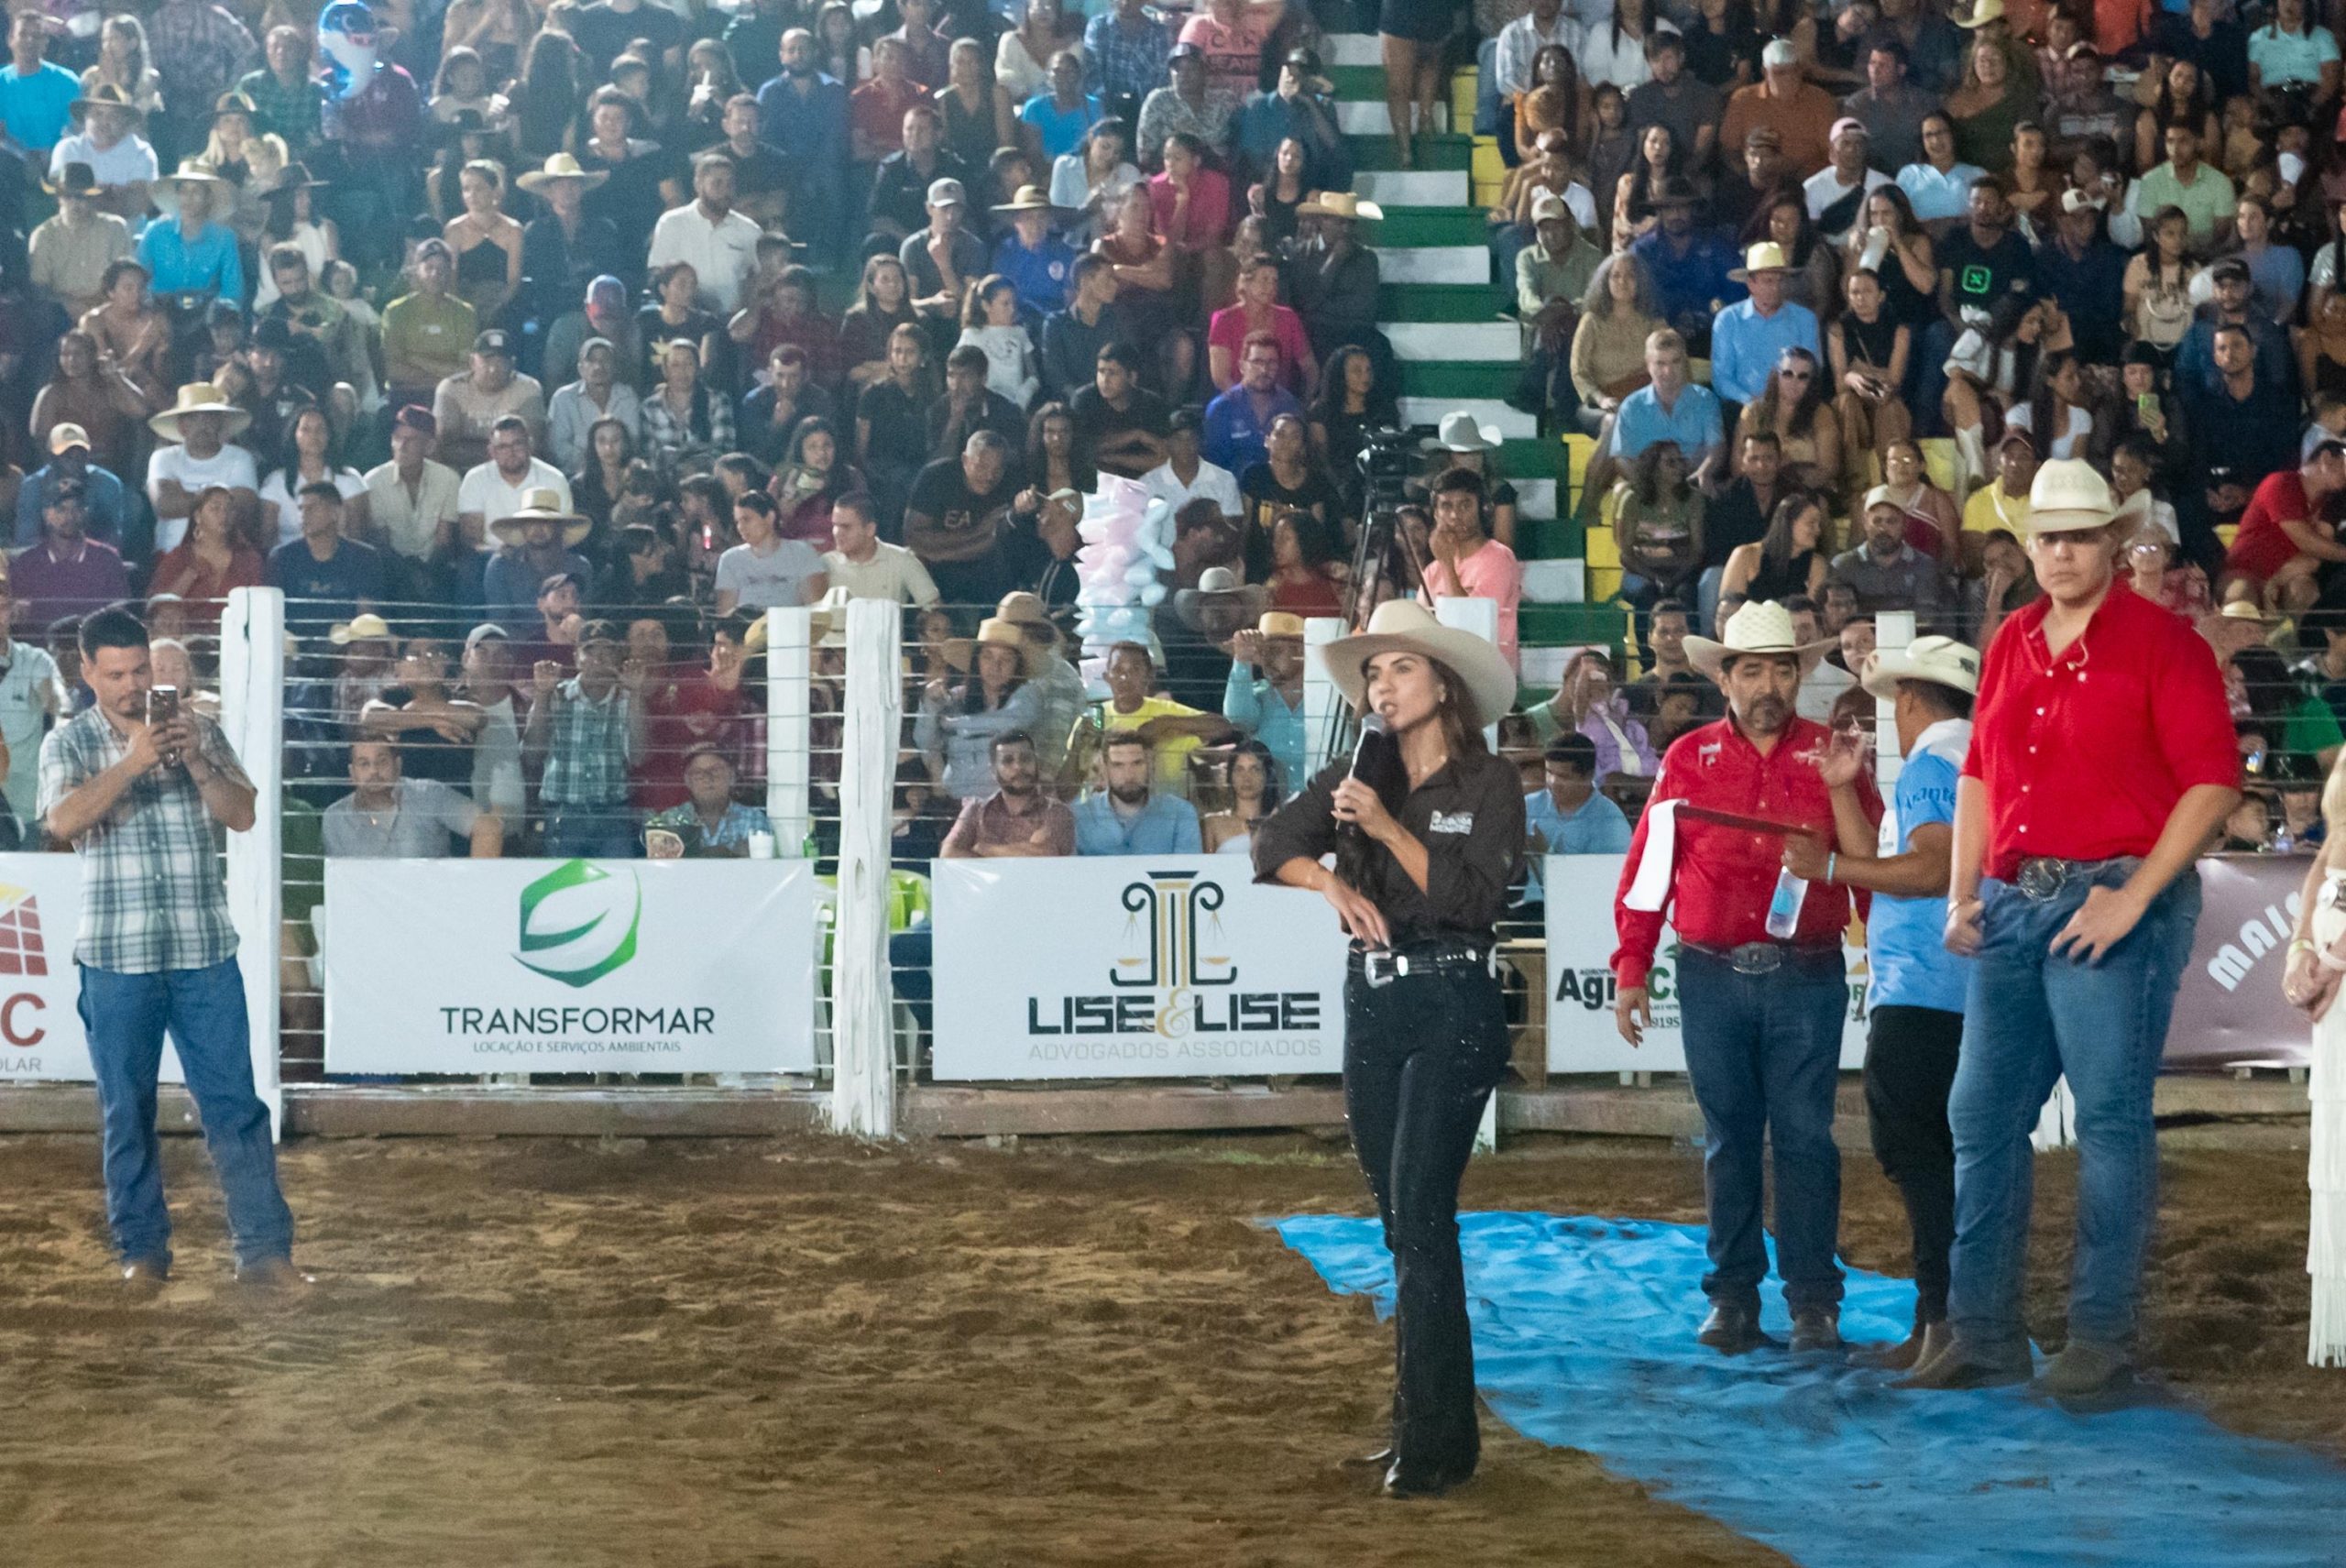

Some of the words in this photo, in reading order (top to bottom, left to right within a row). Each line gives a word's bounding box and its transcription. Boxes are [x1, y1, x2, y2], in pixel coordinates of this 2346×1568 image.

[440, 1007, 715, 1035] TRANSFORMAR
[474, 1039, 534, 1055] LOCAÇÃO
[537, 1042, 543, 1052] E
[546, 1041, 605, 1055] SERVIÇOS
[608, 1041, 681, 1053] AMBIENTAIS
[1028, 1041, 1170, 1061] ADVOGADOS
[1176, 1038, 1322, 1058] ASSOCIADOS
